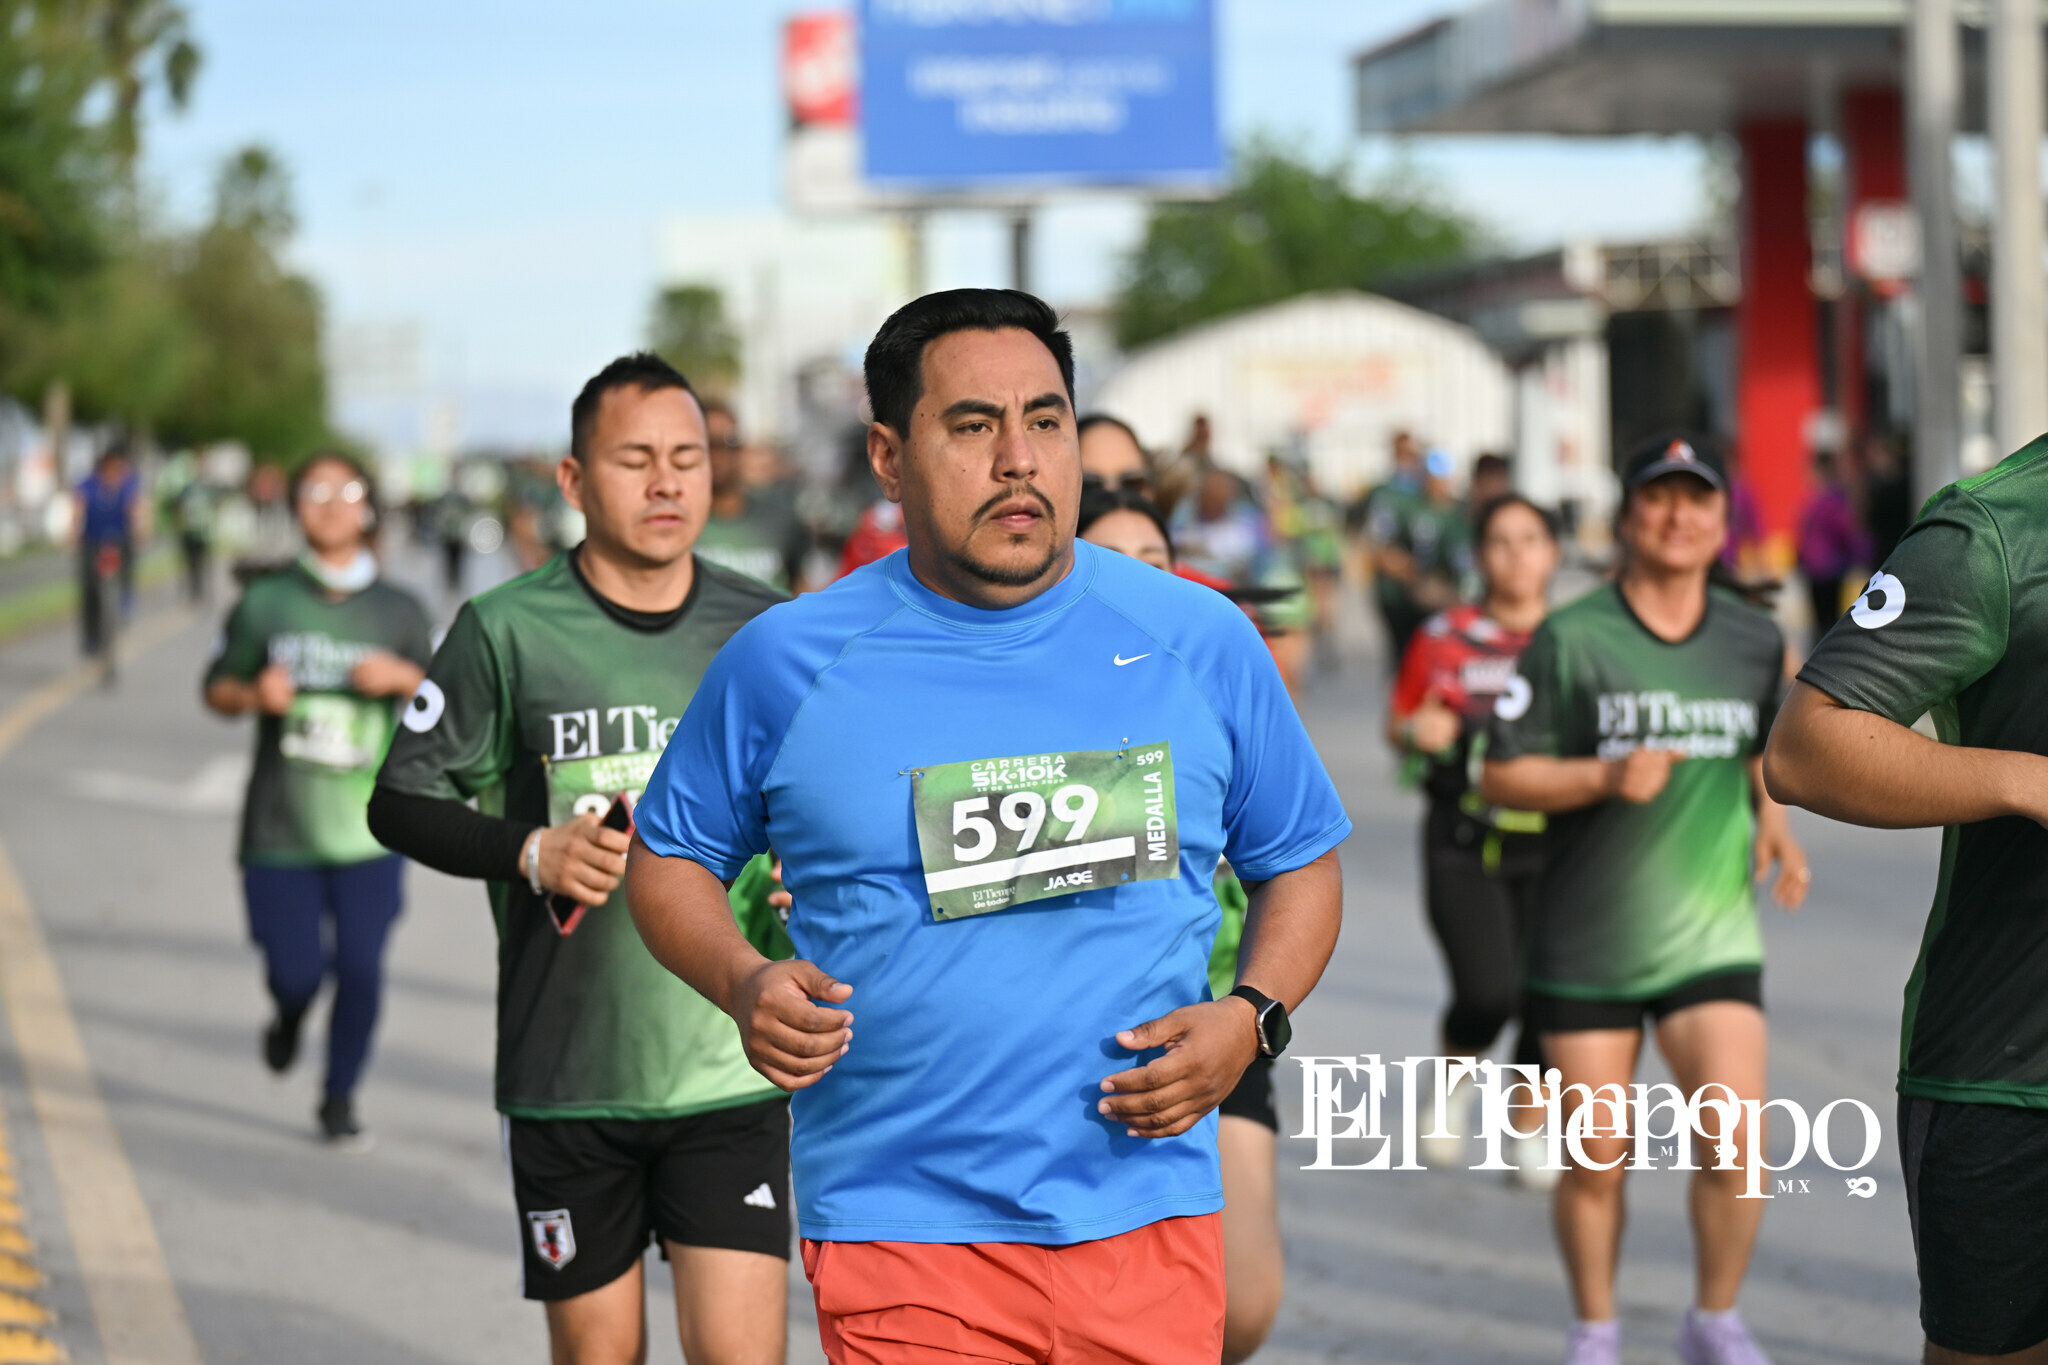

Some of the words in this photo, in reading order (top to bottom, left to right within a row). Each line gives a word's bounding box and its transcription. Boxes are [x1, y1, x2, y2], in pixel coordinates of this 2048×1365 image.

[548, 707, 602, 761] El
[1136, 749, 1164, 766] 599
[970, 754, 1067, 772] CARRERA
[952, 783, 1099, 862] 599
[1143, 771, 1168, 861] MEDALLA
